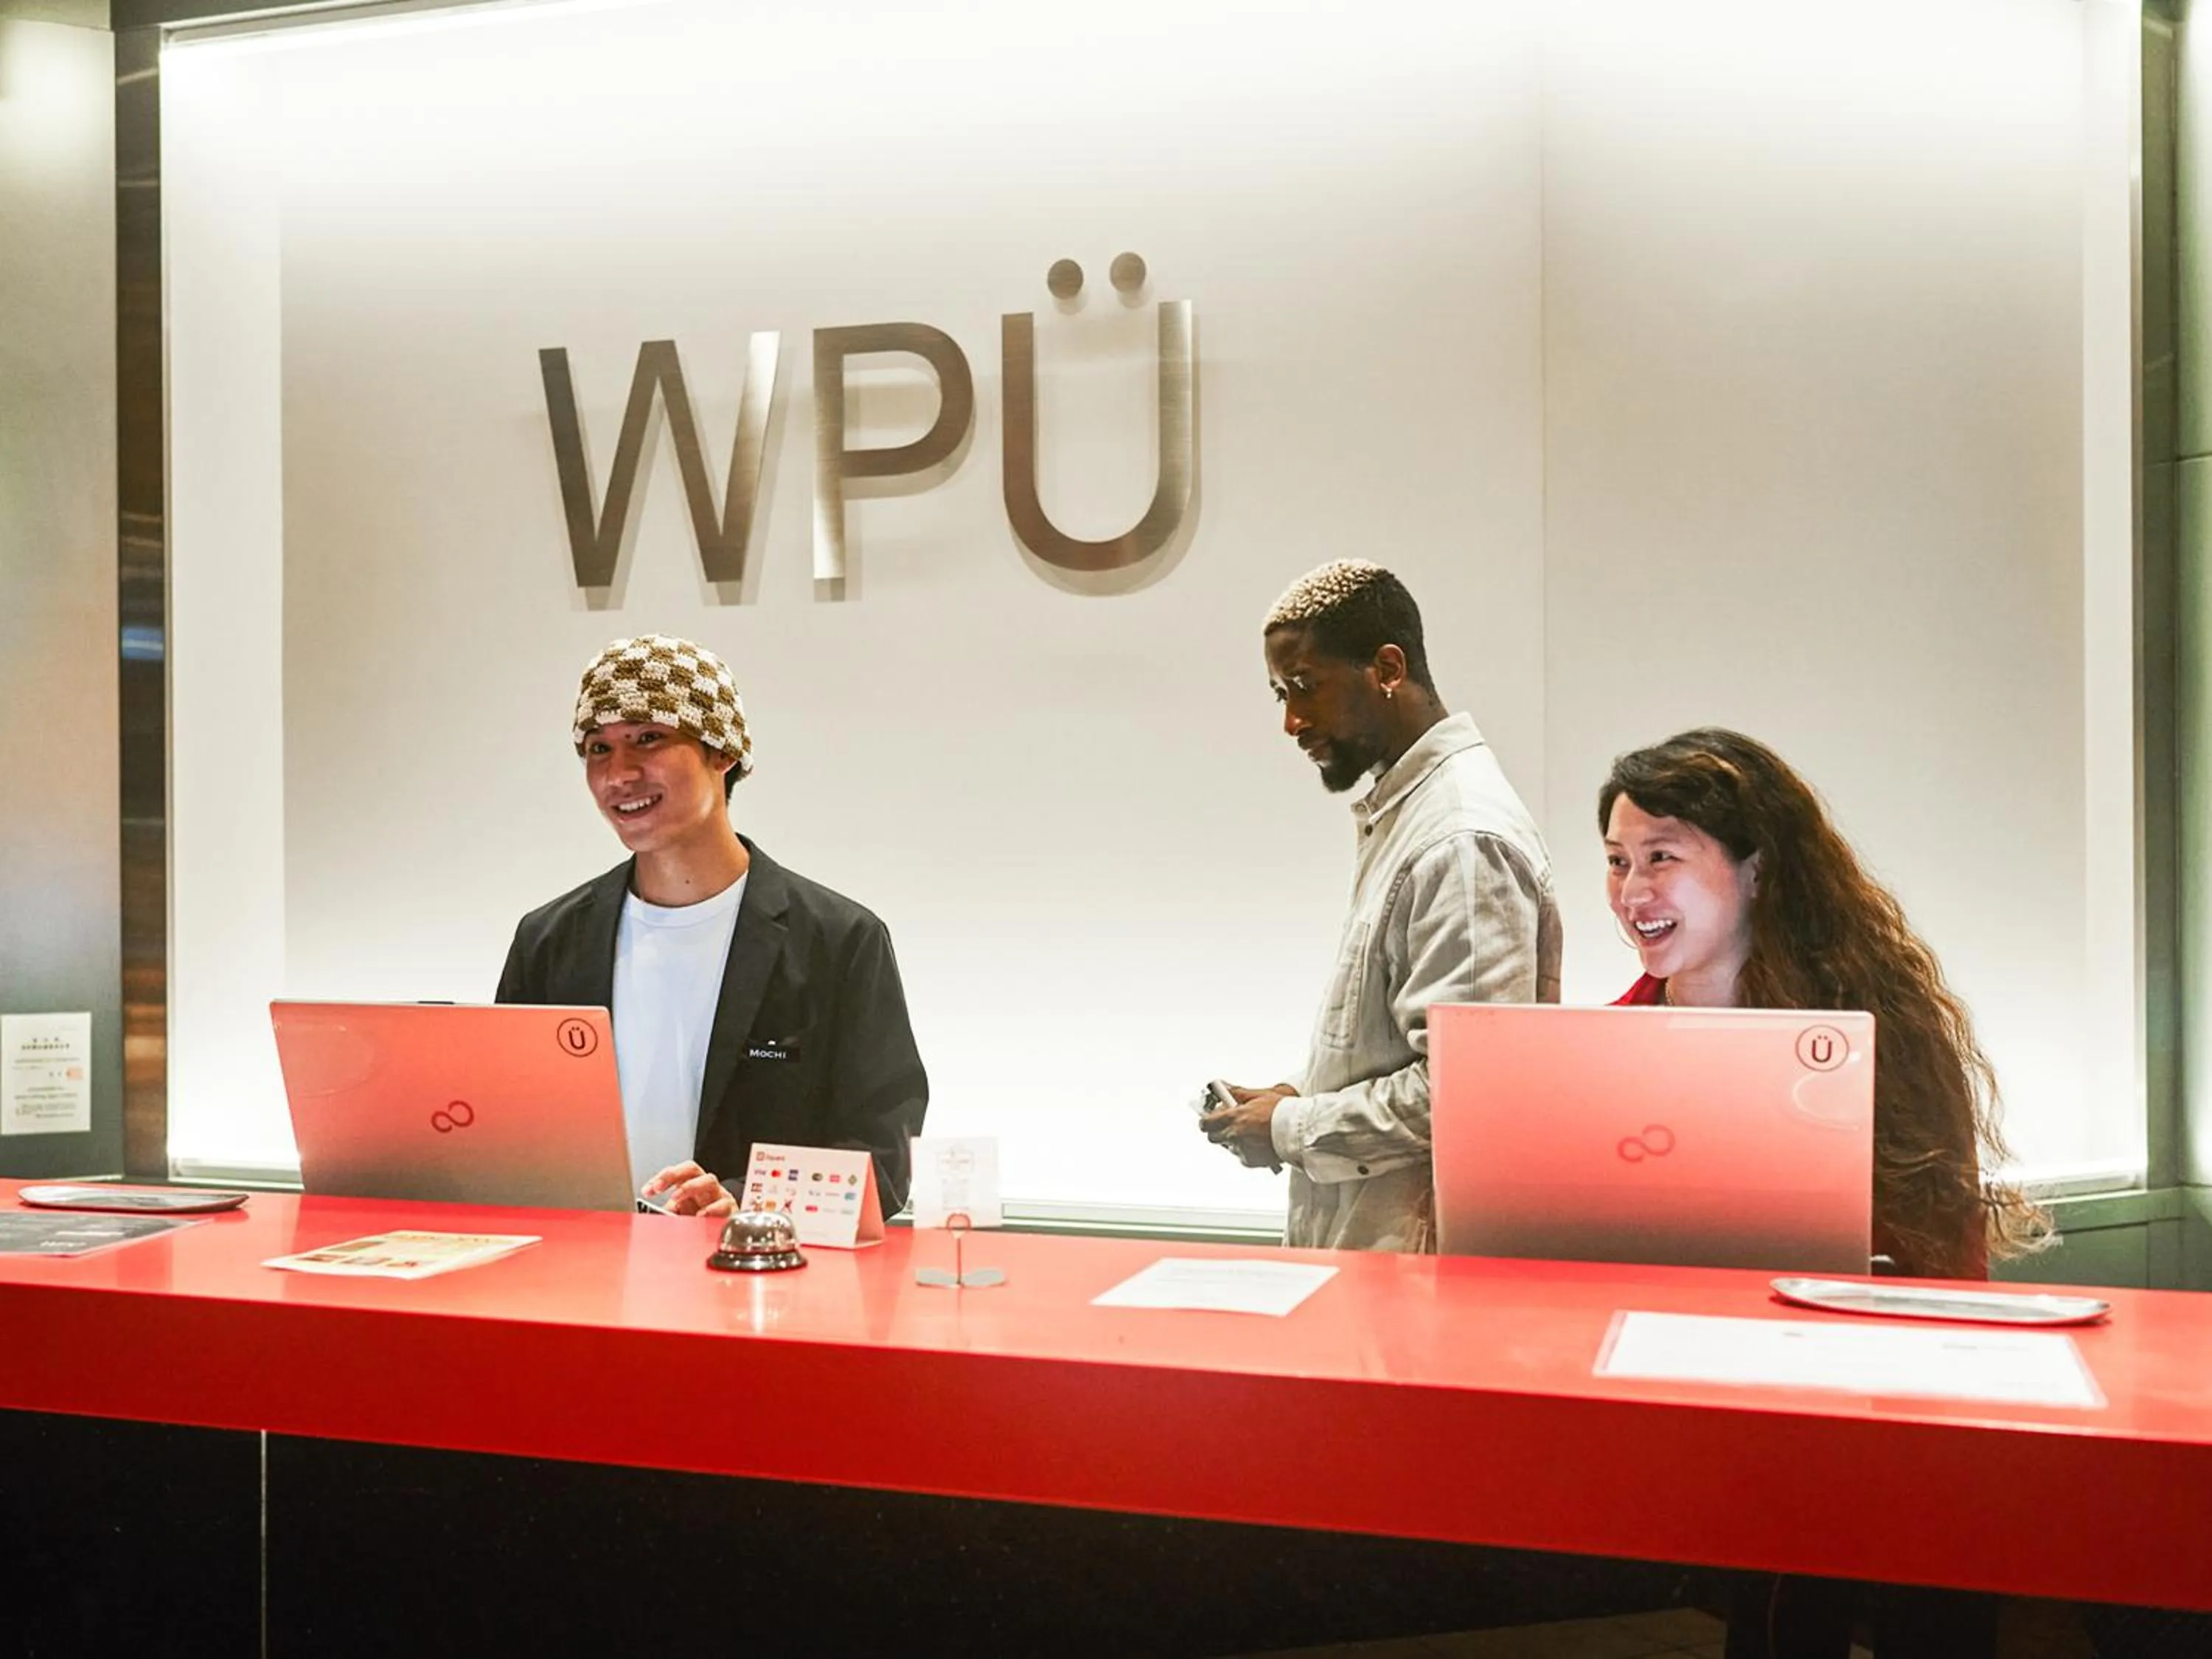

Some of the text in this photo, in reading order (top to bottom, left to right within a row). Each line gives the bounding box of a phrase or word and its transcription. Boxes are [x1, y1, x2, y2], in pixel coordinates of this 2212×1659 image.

[539, 251, 1192, 588] WPÜ
[568, 1026, 585, 1050] Ü
[1812, 1034, 1832, 1062] Ü
[749, 1049, 787, 1060] MOCHI
